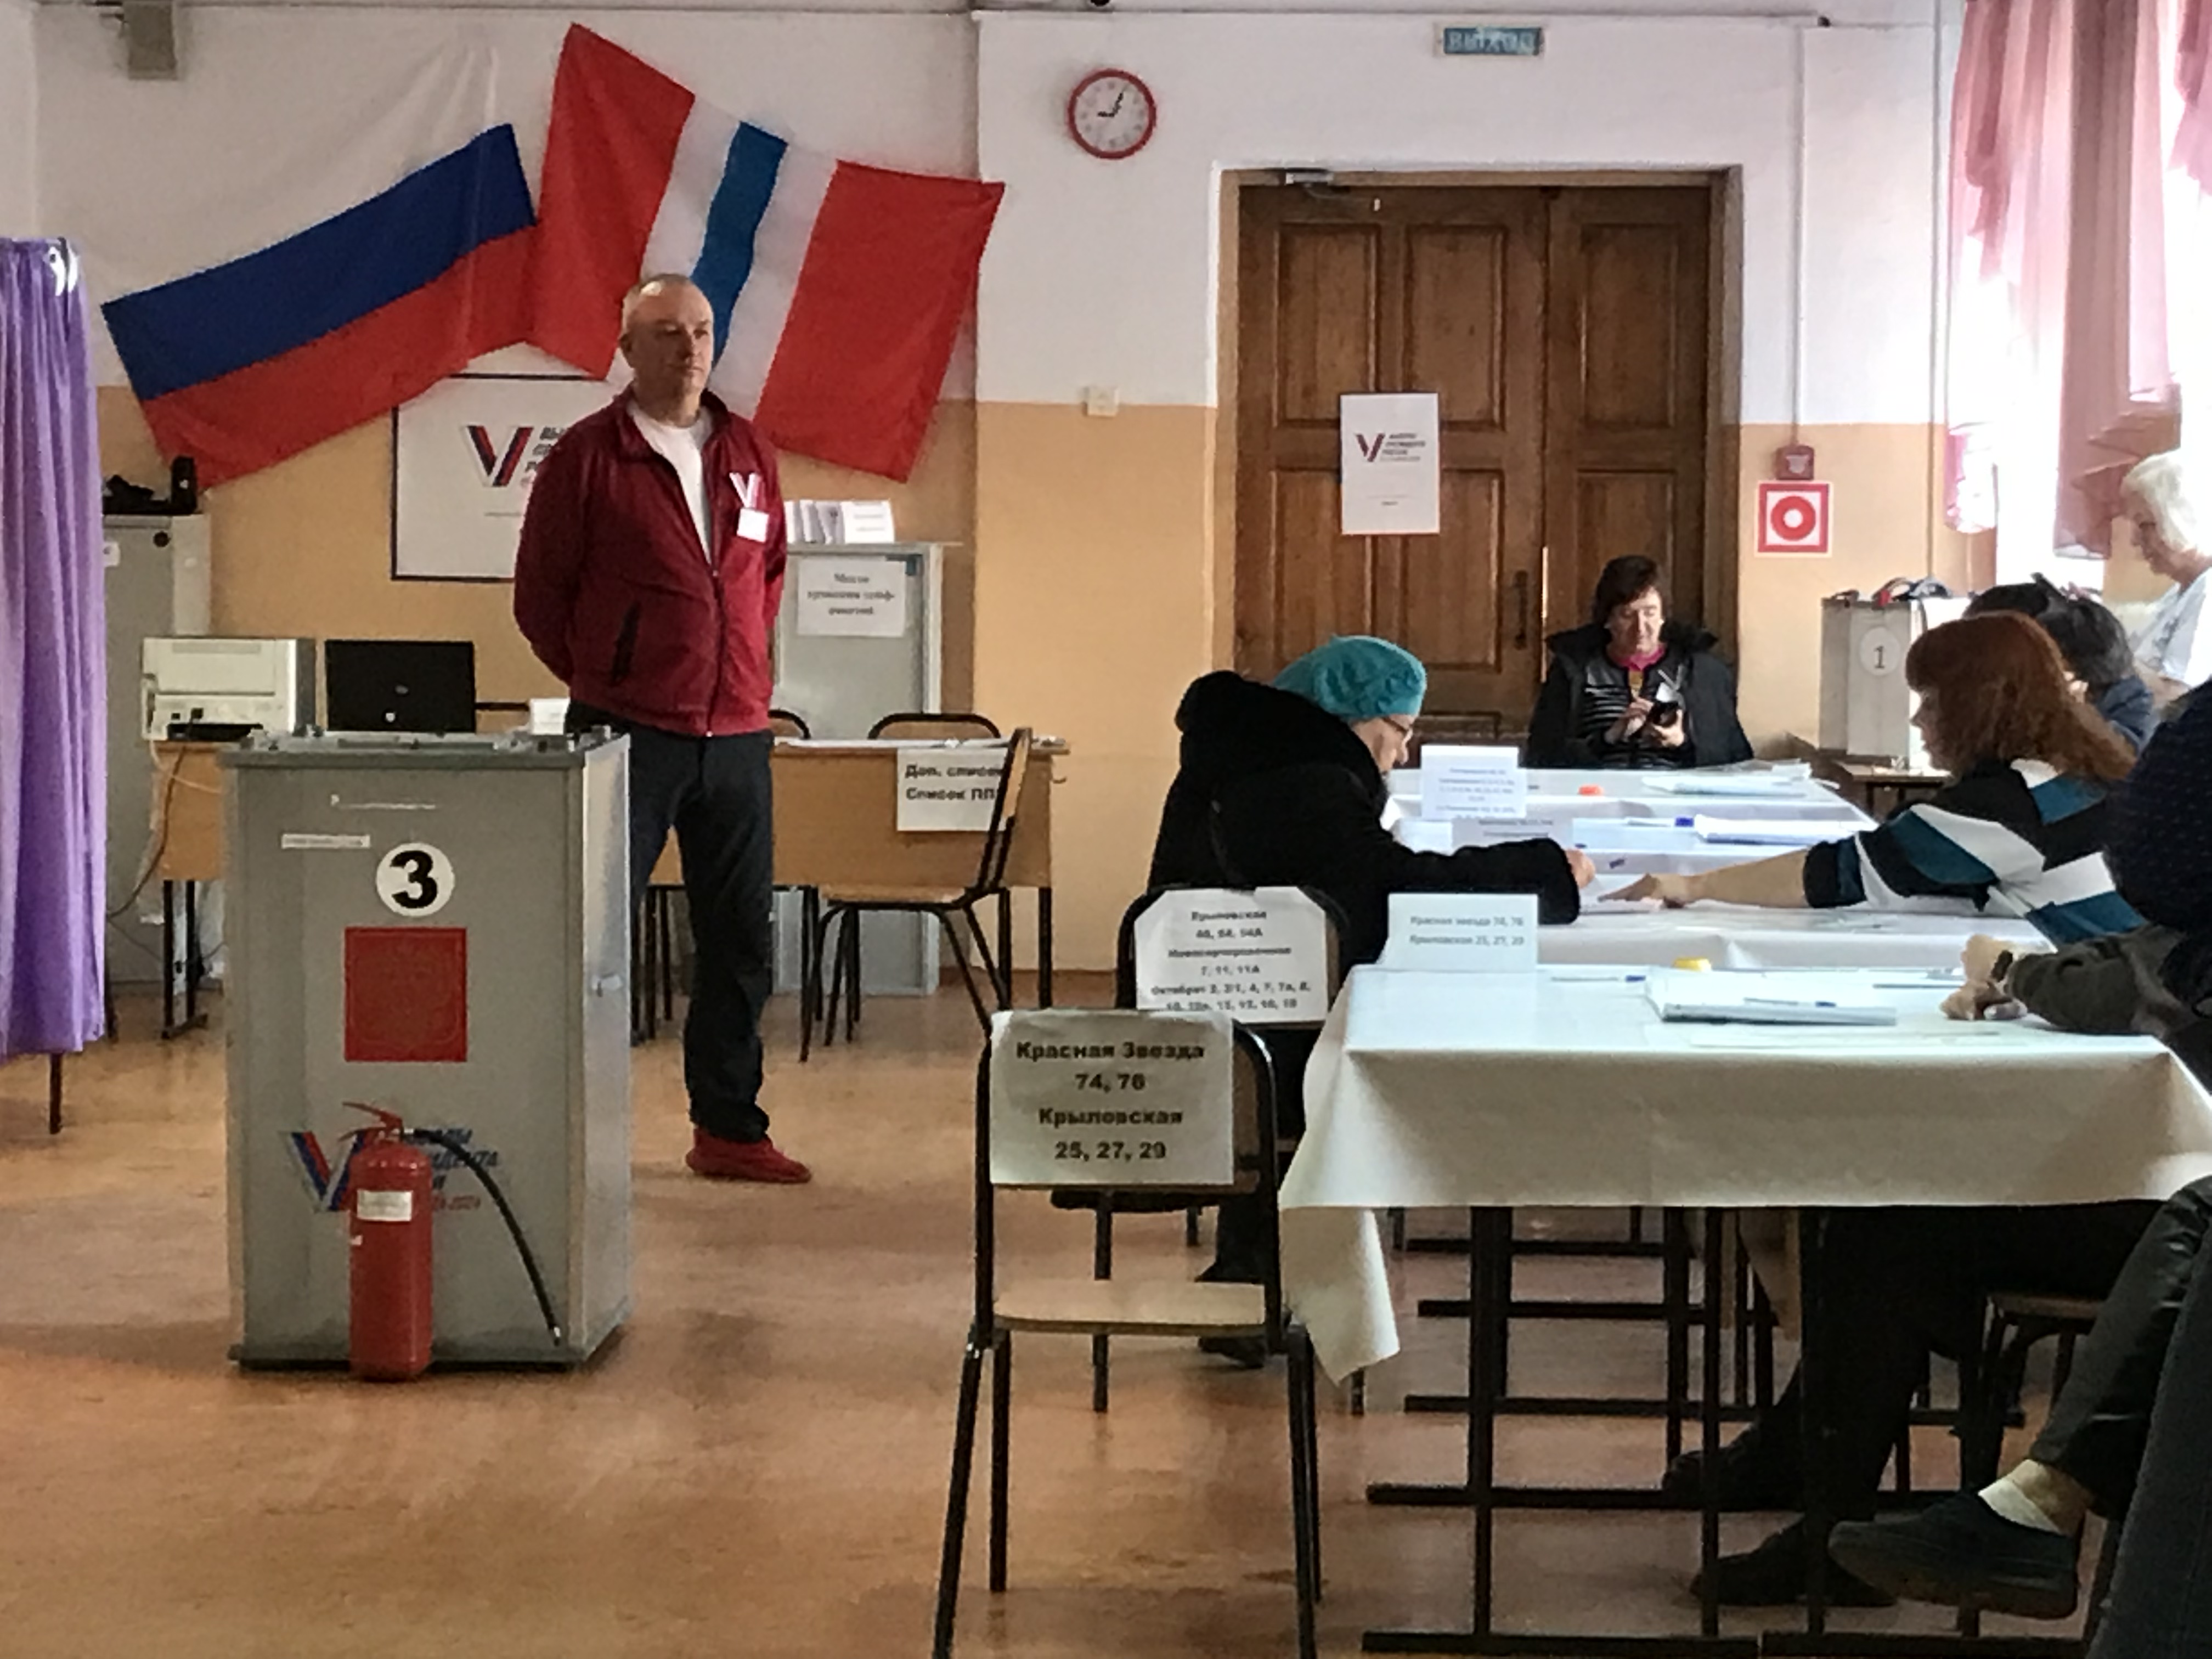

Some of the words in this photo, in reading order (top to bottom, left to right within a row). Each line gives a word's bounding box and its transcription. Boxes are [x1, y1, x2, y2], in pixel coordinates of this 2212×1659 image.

[1874, 645, 1885, 669] 1
[906, 788, 965, 800] Список
[390, 850, 438, 909] 3
[1016, 1042, 1115, 1062] Красная
[1122, 1042, 1205, 1060] Звезда
[1075, 1074, 1111, 1092] 74,
[1039, 1108, 1183, 1128] Крыловская
[1054, 1142, 1090, 1161] 25,
[1096, 1142, 1132, 1161] 27,
[1139, 1142, 1167, 1159] 29
